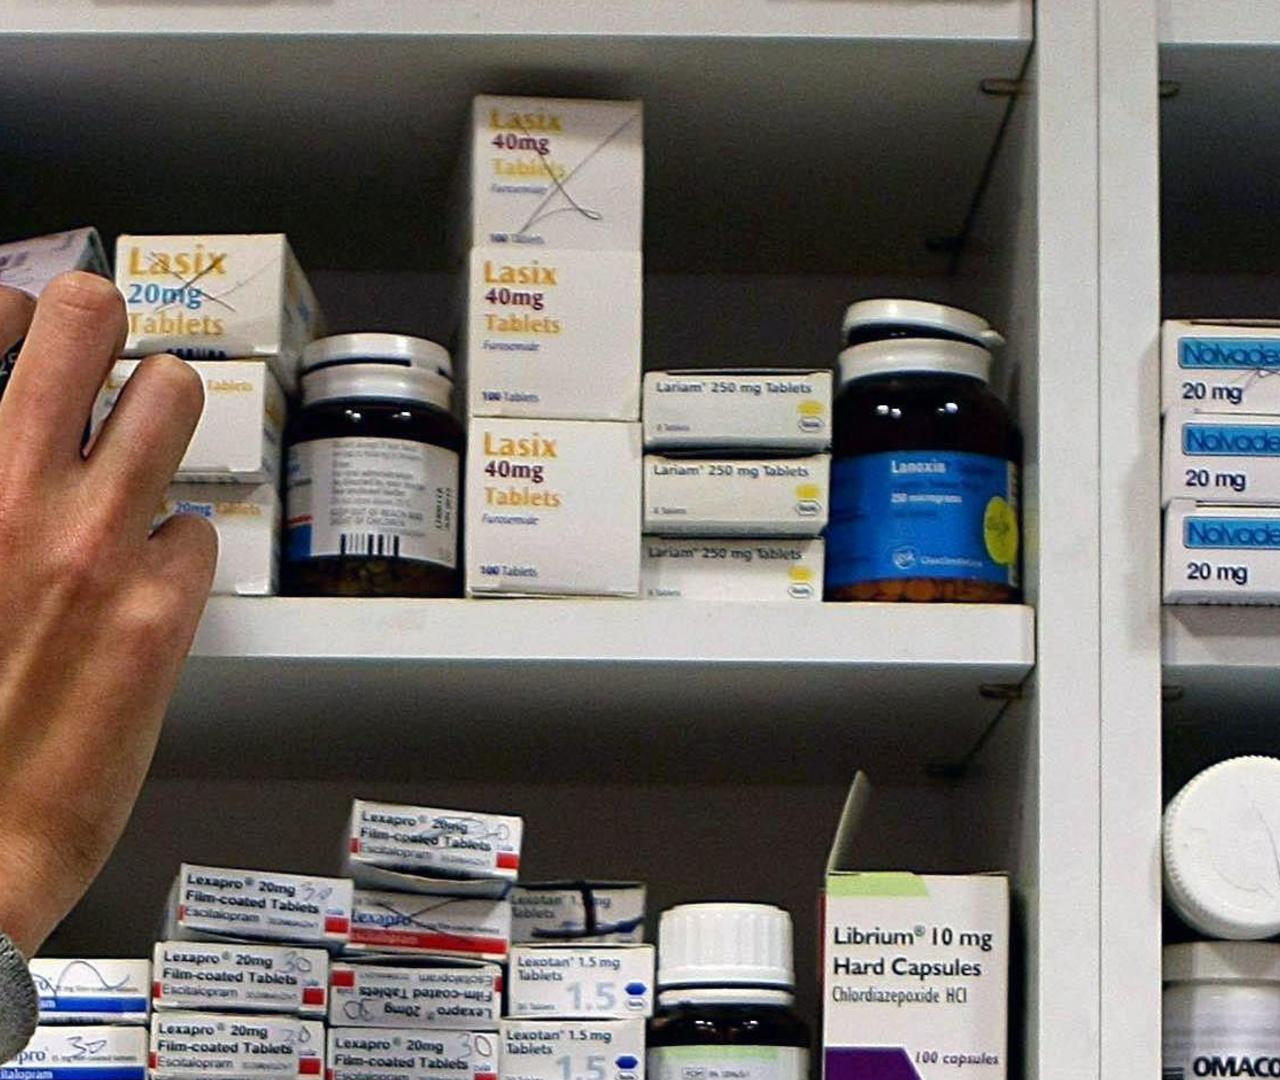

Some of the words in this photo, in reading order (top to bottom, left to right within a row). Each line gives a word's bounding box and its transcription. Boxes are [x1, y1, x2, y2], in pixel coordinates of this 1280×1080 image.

[129, 246, 227, 276] Lasix
[483, 262, 558, 285] Lasix
[128, 283, 203, 309] 20mg
[485, 289, 544, 309] 40mg
[128, 311, 222, 336] Tablets
[485, 315, 560, 334] Tablets
[711, 383, 736, 394] 250
[740, 385, 761, 395] mg
[765, 382, 812, 394] Tablets
[1187, 563, 1216, 581] 20
[1221, 567, 1248, 584] mg
[931, 928, 953, 946] 10
[959, 931, 993, 951] mg
[163, 951, 220, 965] Lexapro
[235, 954, 273, 968] 20mg
[833, 958, 885, 976] Hard
[892, 958, 982, 980] Capsules
[163, 968, 244, 982] Film-coated
[249, 971, 297, 985] Tablets
[832, 987, 940, 1006] Chlordiazepoxide
[593, 1032, 611, 1044] mg
[506, 1042, 553, 1055] Tablets
[915, 1052, 938, 1065] 100
[942, 1053, 999, 1068] capsules
